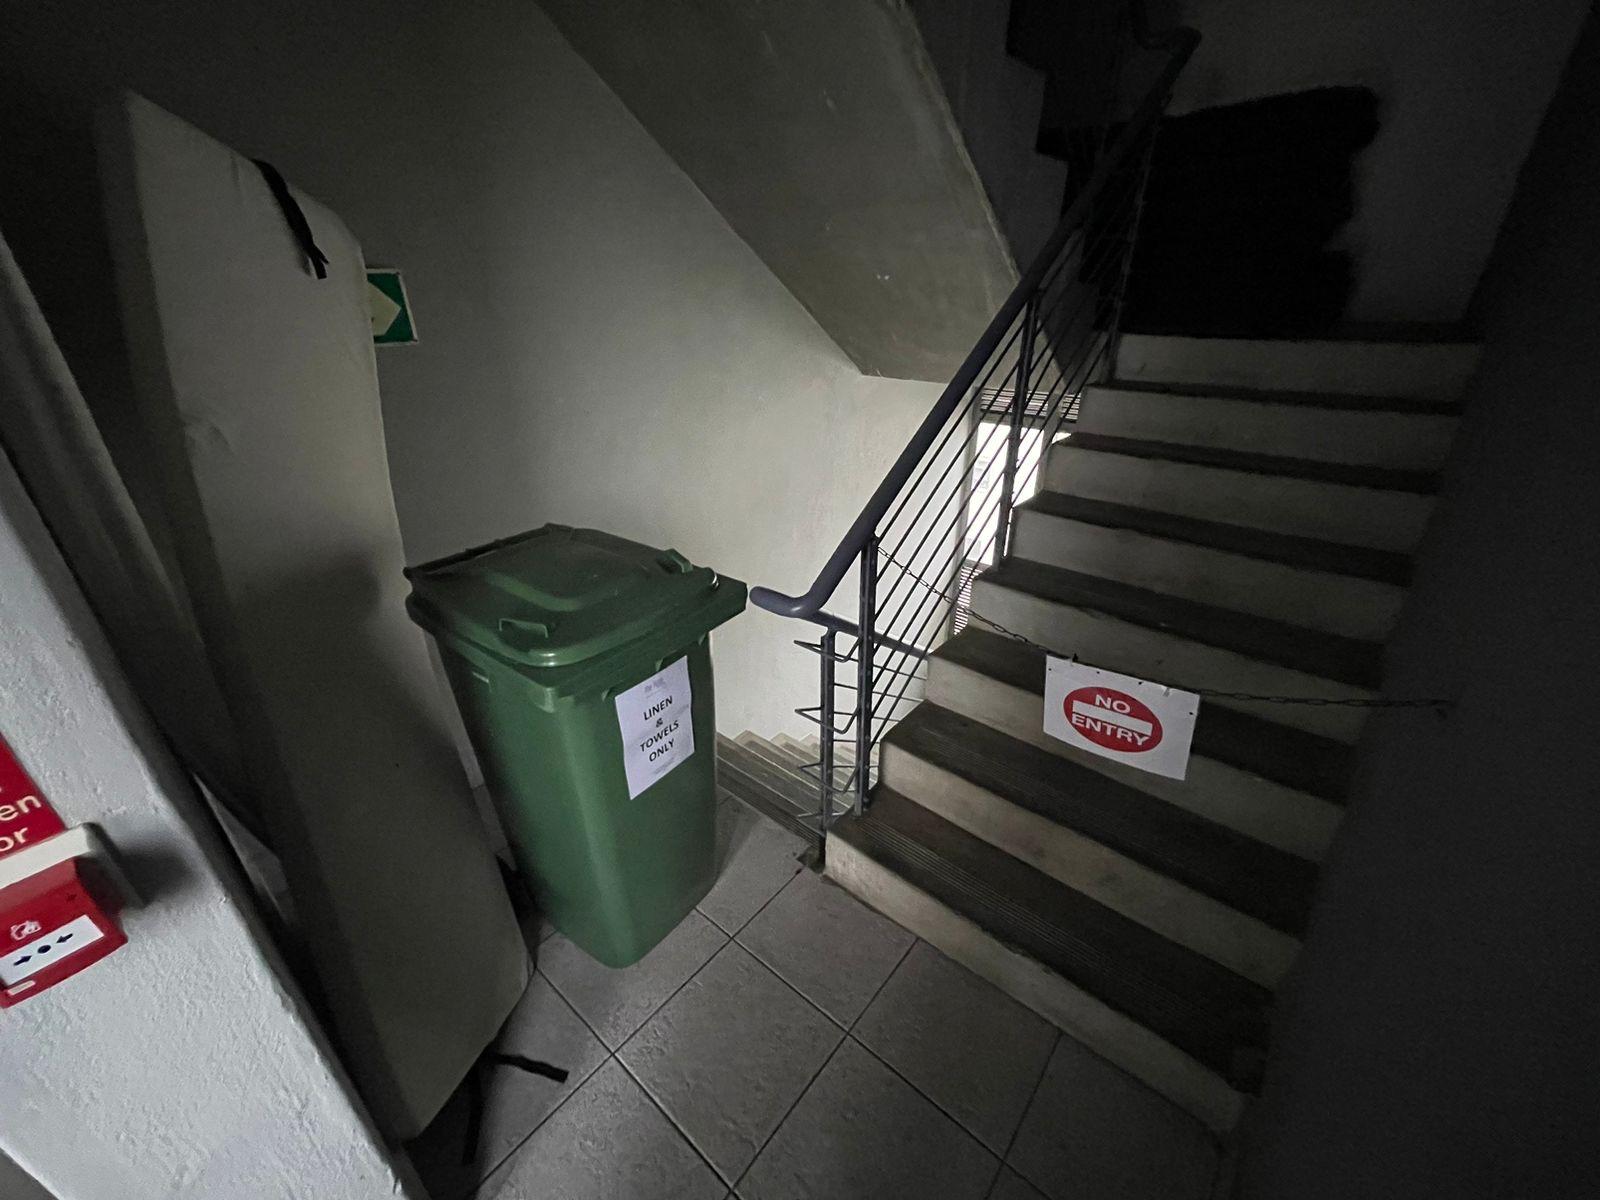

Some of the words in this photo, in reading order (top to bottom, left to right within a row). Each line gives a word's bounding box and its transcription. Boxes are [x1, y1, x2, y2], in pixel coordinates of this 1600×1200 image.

[644, 696, 673, 720] LINEN
[1095, 694, 1130, 713] NO
[656, 717, 664, 728] &
[1072, 714, 1149, 746] ENTRY
[640, 720, 679, 752] TOWELS
[649, 740, 674, 762] ONLY
